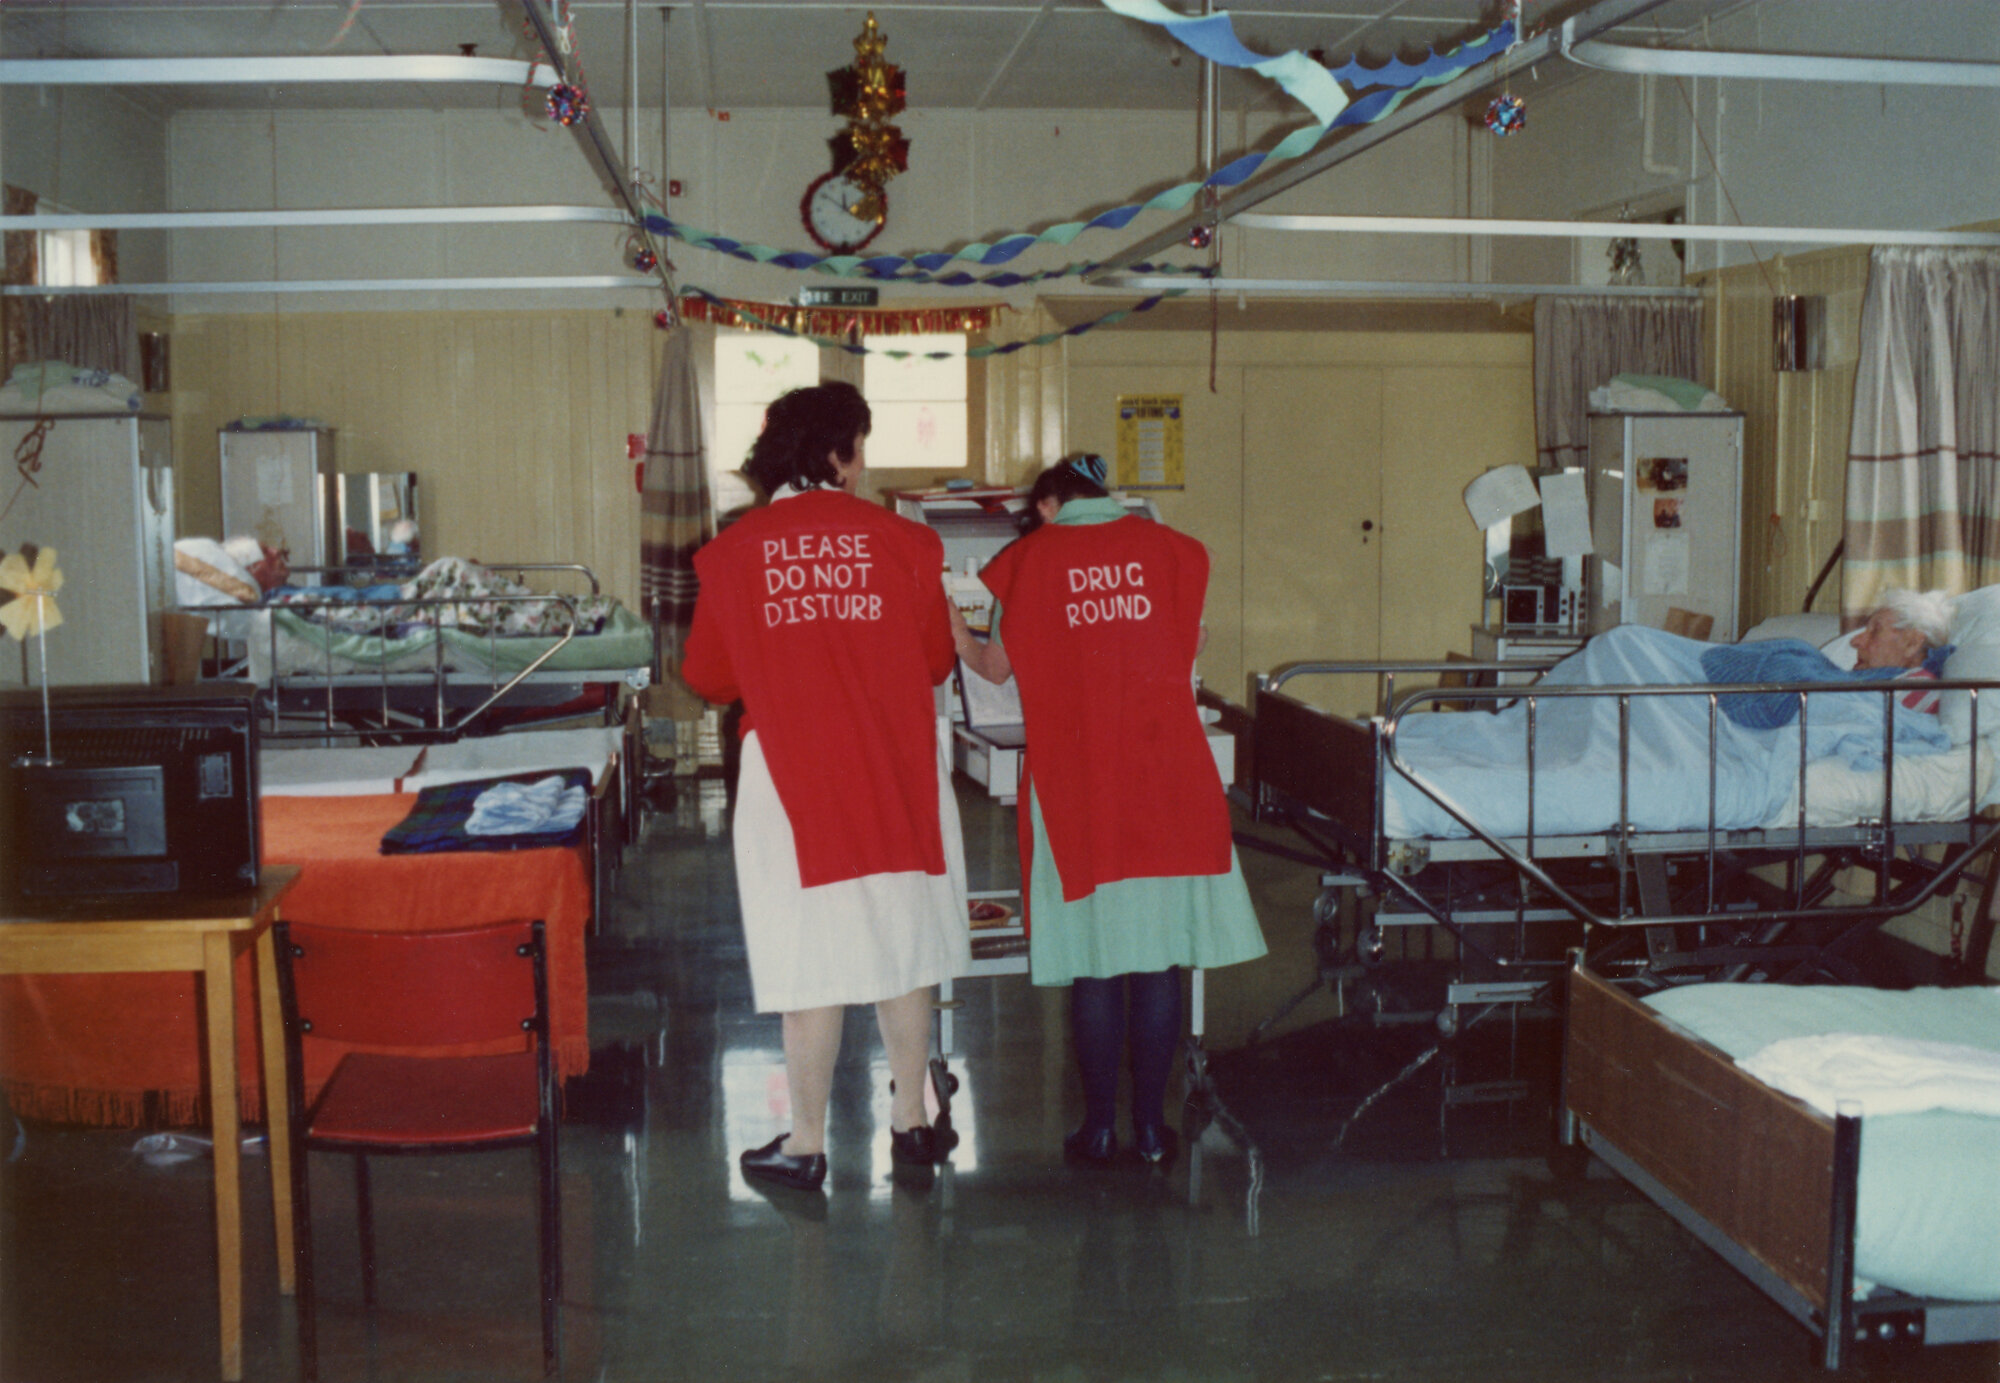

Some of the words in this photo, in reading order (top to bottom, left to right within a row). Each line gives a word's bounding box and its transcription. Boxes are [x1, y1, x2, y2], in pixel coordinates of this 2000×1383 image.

[842, 291, 869, 303] EXIT
[763, 534, 871, 564] PLEASE
[765, 565, 806, 595] DO
[813, 563, 873, 588] NOT
[1068, 562, 1144, 592] DRUG
[764, 593, 882, 628] DISTURB
[1066, 594, 1151, 628] ROUND
